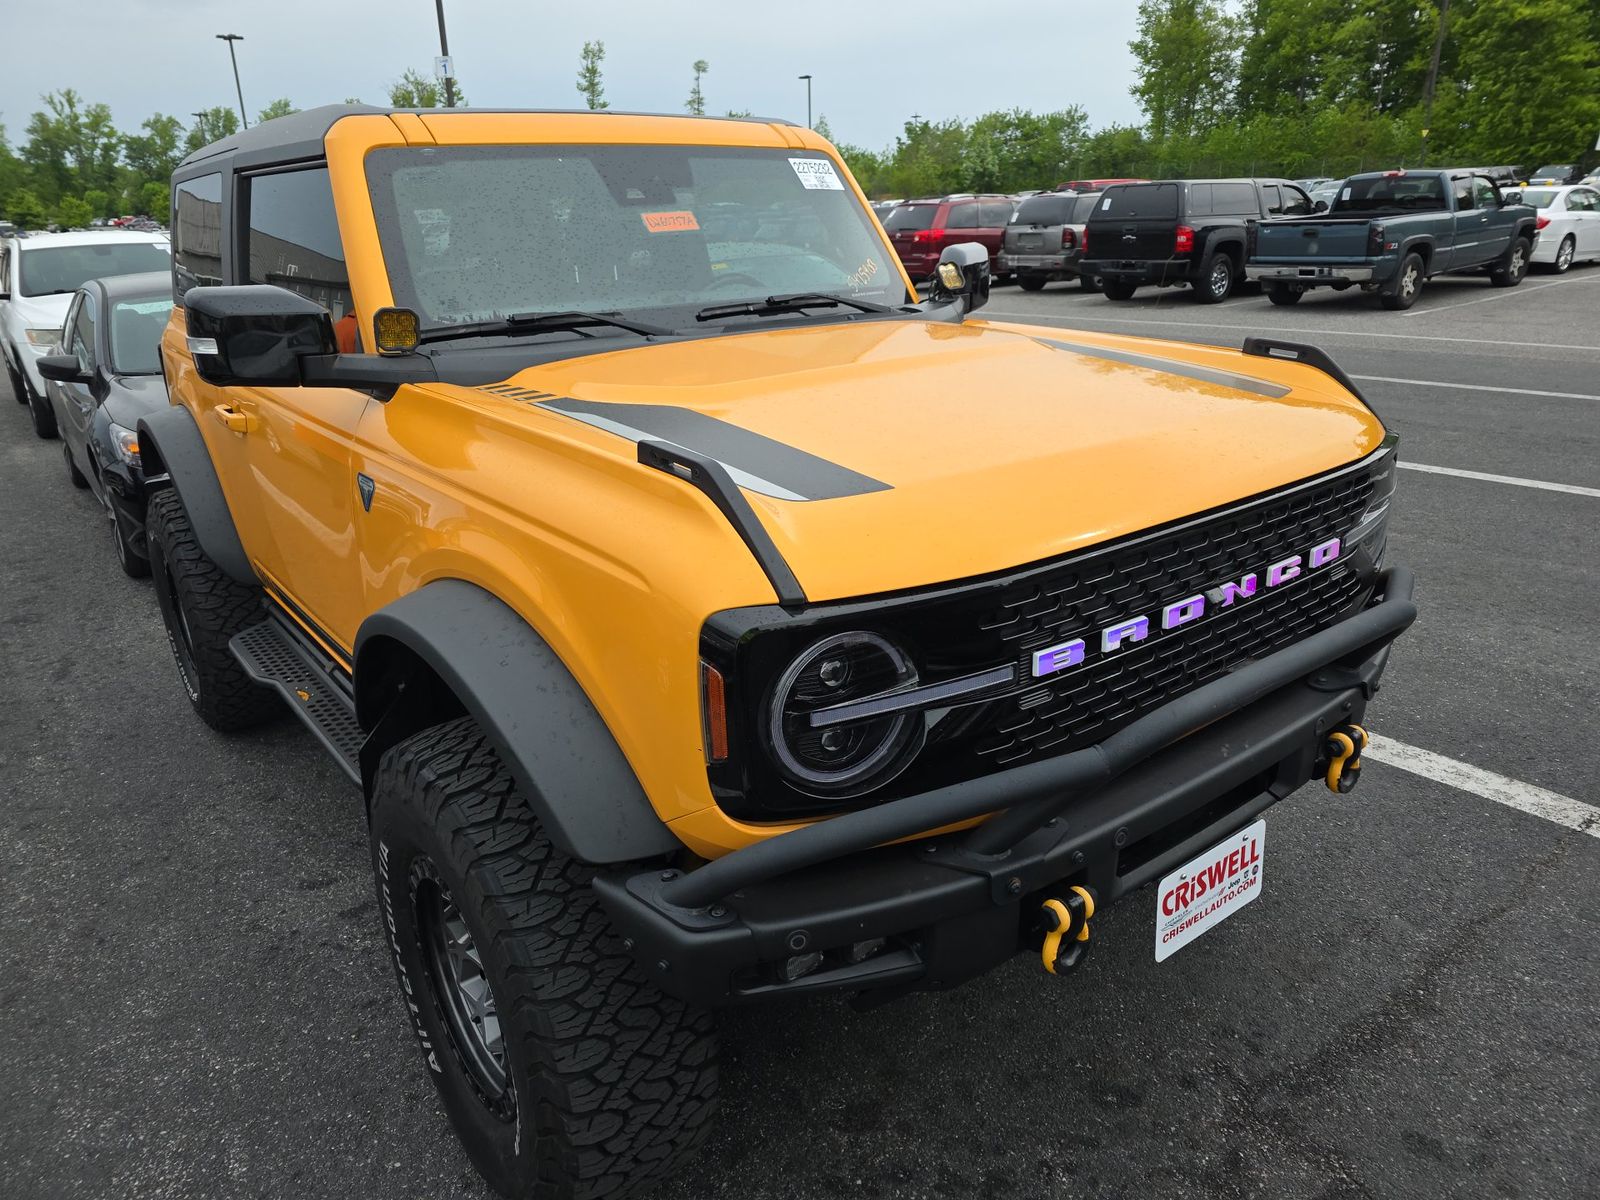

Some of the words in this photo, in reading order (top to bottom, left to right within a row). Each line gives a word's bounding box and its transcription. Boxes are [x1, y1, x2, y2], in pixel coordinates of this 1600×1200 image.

[441, 63, 447, 74] 1
[793, 161, 833, 174] 2275232
[1032, 537, 1341, 677] BRONCO
[1162, 877, 1257, 943] CRISWELLAUTO.COM
